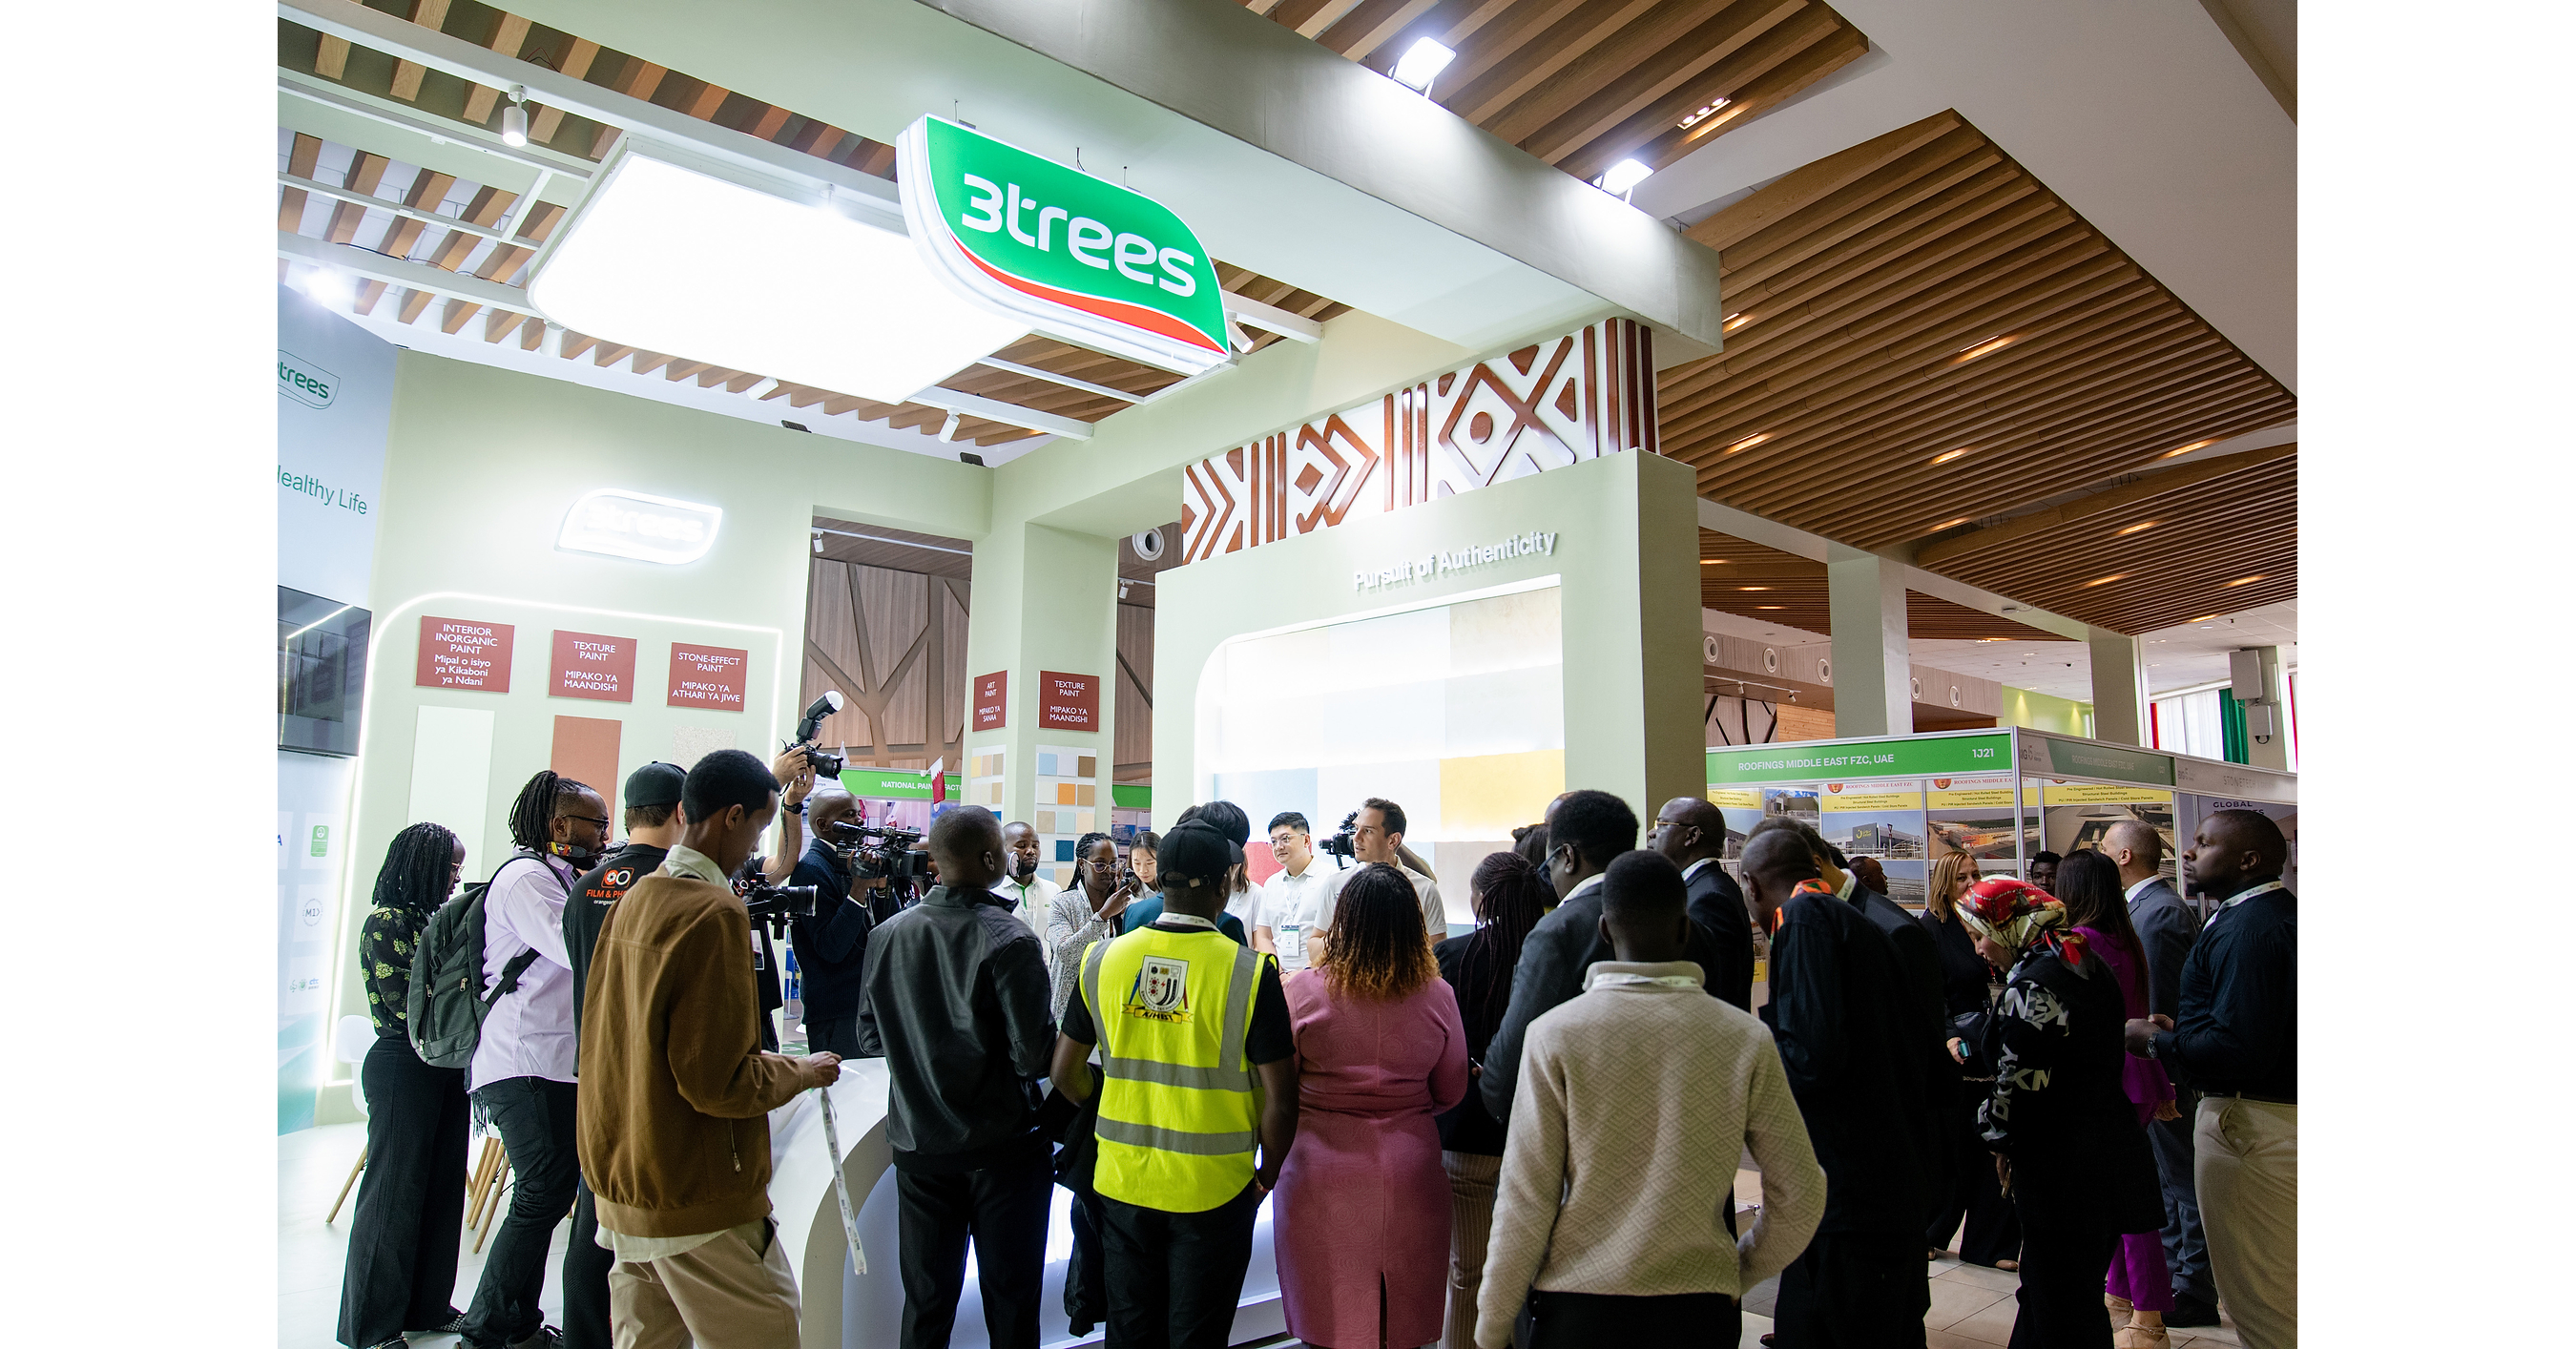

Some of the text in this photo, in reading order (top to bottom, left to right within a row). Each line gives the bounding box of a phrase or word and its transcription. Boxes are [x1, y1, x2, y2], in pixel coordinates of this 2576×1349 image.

[962, 173, 1195, 297] 3trees
[278, 362, 329, 399] trees
[339, 488, 367, 515] Life
[1354, 530, 1557, 591] Pursuit of Authenticity
[443, 624, 492, 636] INTERIOR
[435, 633, 498, 646] INORGANIC
[450, 644, 483, 654] PAINT
[573, 641, 615, 654] TEXTURE
[434, 654, 459, 665] Mipal
[470, 658, 490, 668] isiyo
[580, 652, 609, 661] PAINT
[678, 653, 740, 666] STONE-EFFECT
[435, 666, 488, 676] ya Kikaboni
[697, 663, 723, 673] PAINT
[442, 676, 483, 686] ya Ndani
[566, 670, 618, 683] MIPAKO YA
[564, 679, 617, 692] MAANDISHI
[682, 681, 730, 693] MIPAKO YA
[1054, 680, 1085, 690] TEXTURE
[673, 690, 705, 699] ATHARI
[720, 694, 740, 703] JIWE
[985, 689, 997, 697] PAINT
[1050, 706, 1077, 715] MIPAKO
[1049, 714, 1088, 723] MAANDISHI
[1738, 748, 1994, 771] ROOFINGS MIDDLE EAST FZC, UAE 1J21
[882, 781, 916, 790] NATIONAL
[586, 889, 605, 898] FILM
